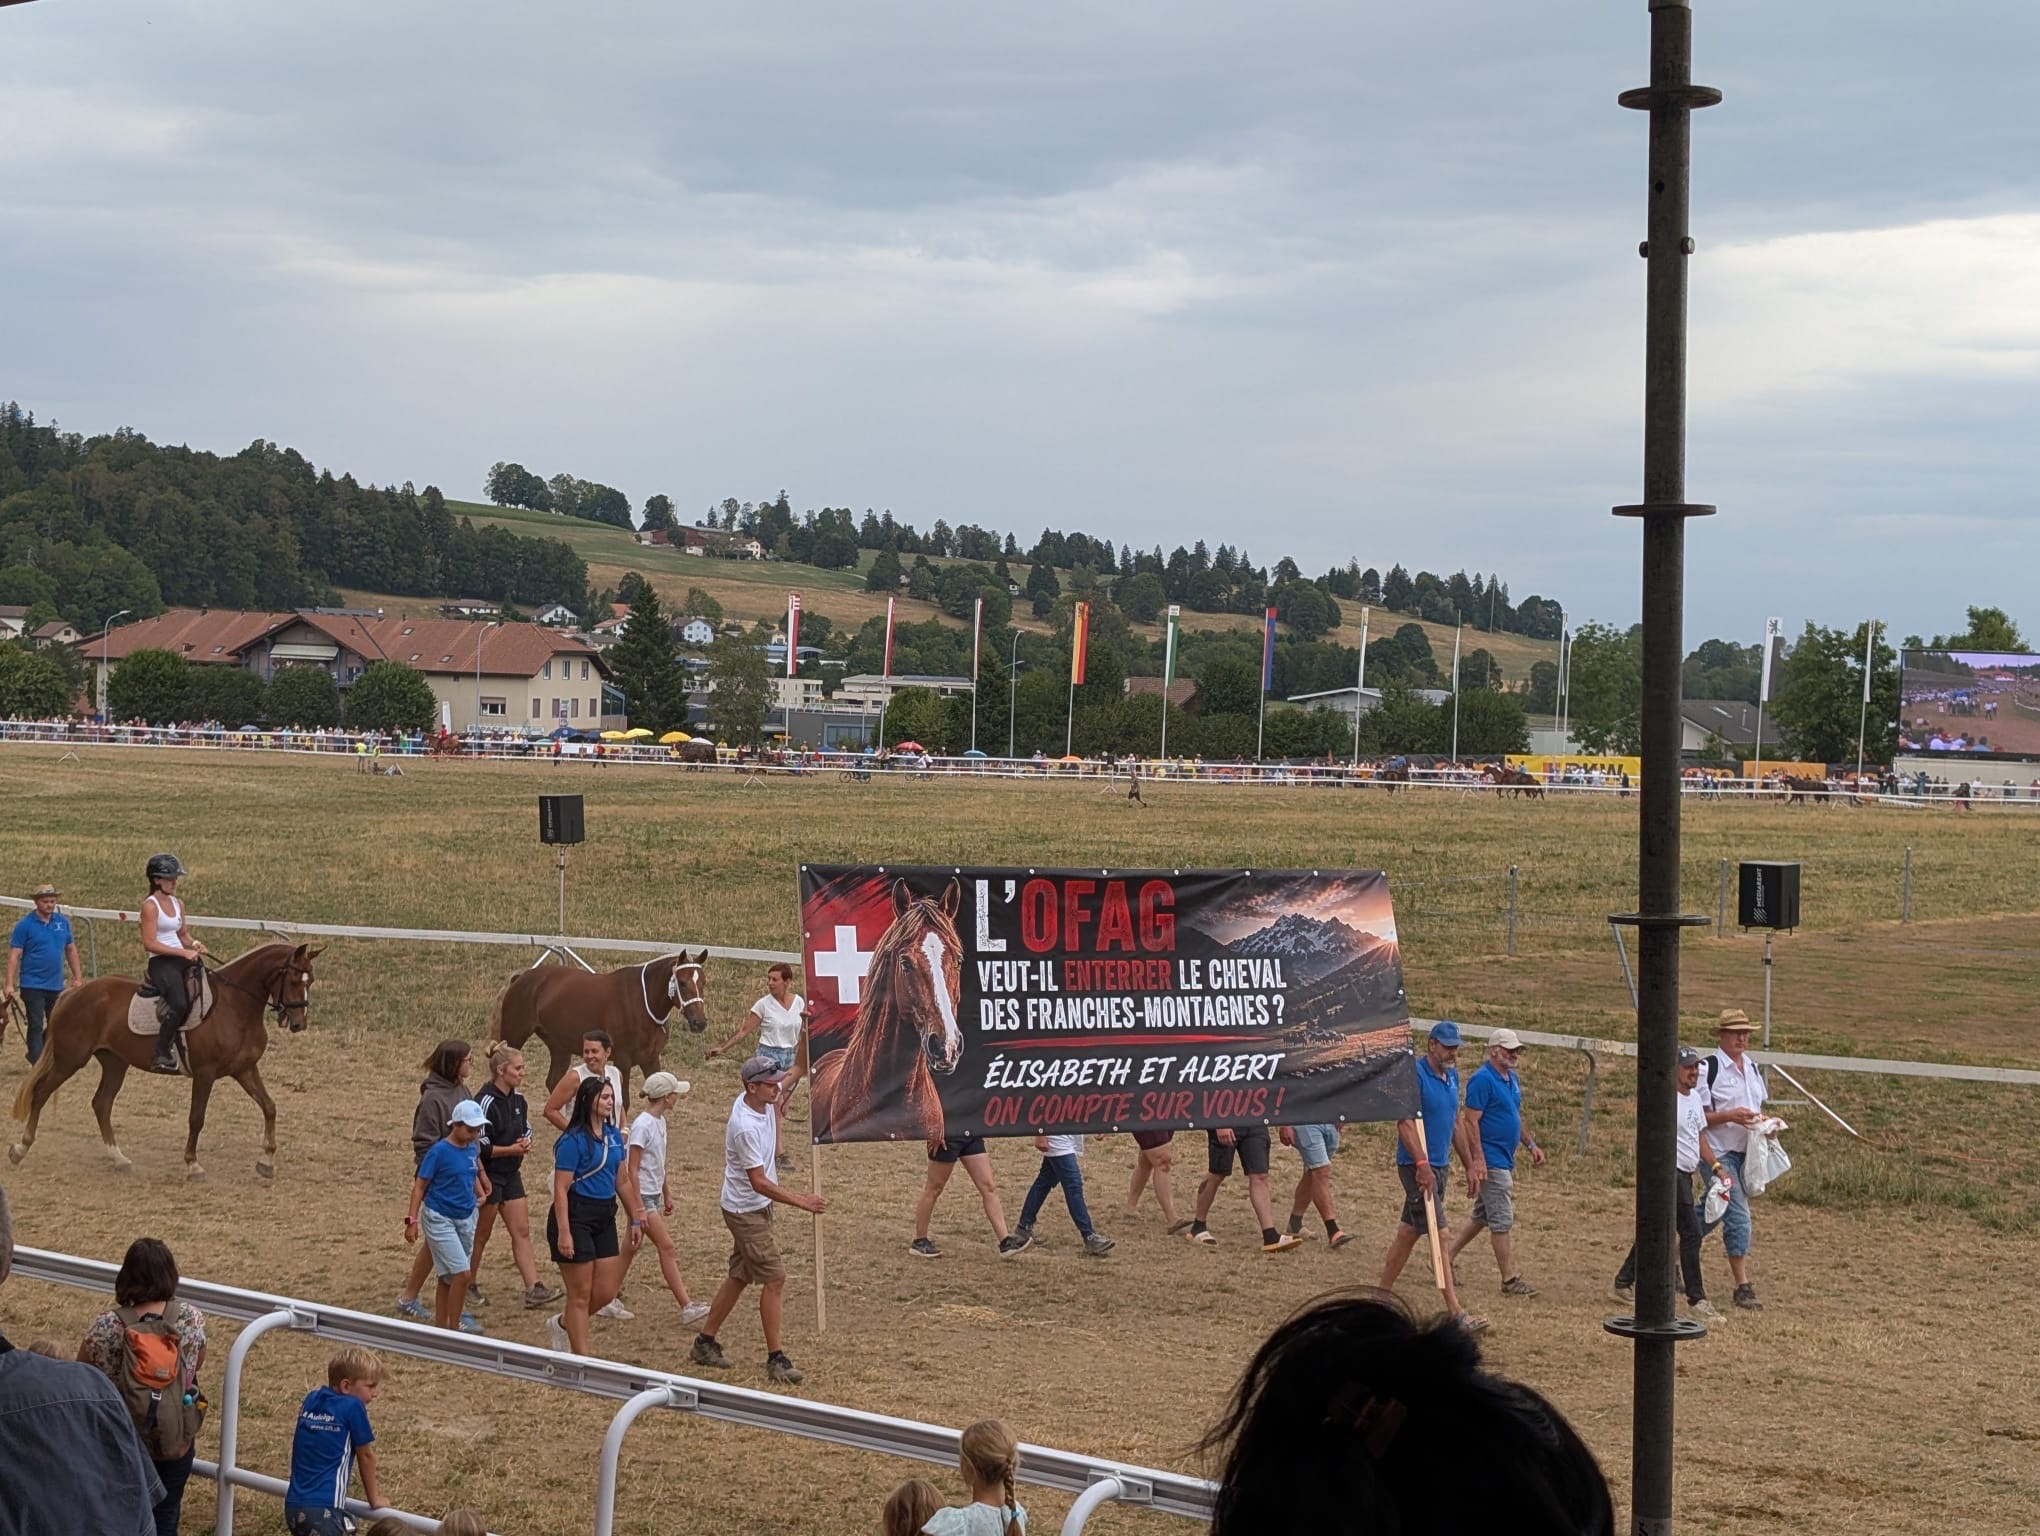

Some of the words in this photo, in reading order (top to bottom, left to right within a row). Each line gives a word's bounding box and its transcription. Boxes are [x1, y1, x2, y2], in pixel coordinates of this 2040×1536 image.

[976, 879, 1176, 953] L'OFAG
[977, 960, 1059, 992] VEUT-IL
[1064, 959, 1173, 991] ENTERRER
[1179, 959, 1203, 990] LE
[1208, 958, 1288, 990] CHEVAL
[980, 998, 1020, 1031] DES
[983, 1053, 1132, 1088] ÉLISABETH
[1138, 1056, 1177, 1084] ET
[1178, 1053, 1286, 1083] ALBERT
[983, 1095, 1024, 1127] ON
[1028, 1093, 1135, 1125] COMPTE
[1139, 1090, 1194, 1121] SUR
[1202, 1087, 1268, 1118] VOUS
